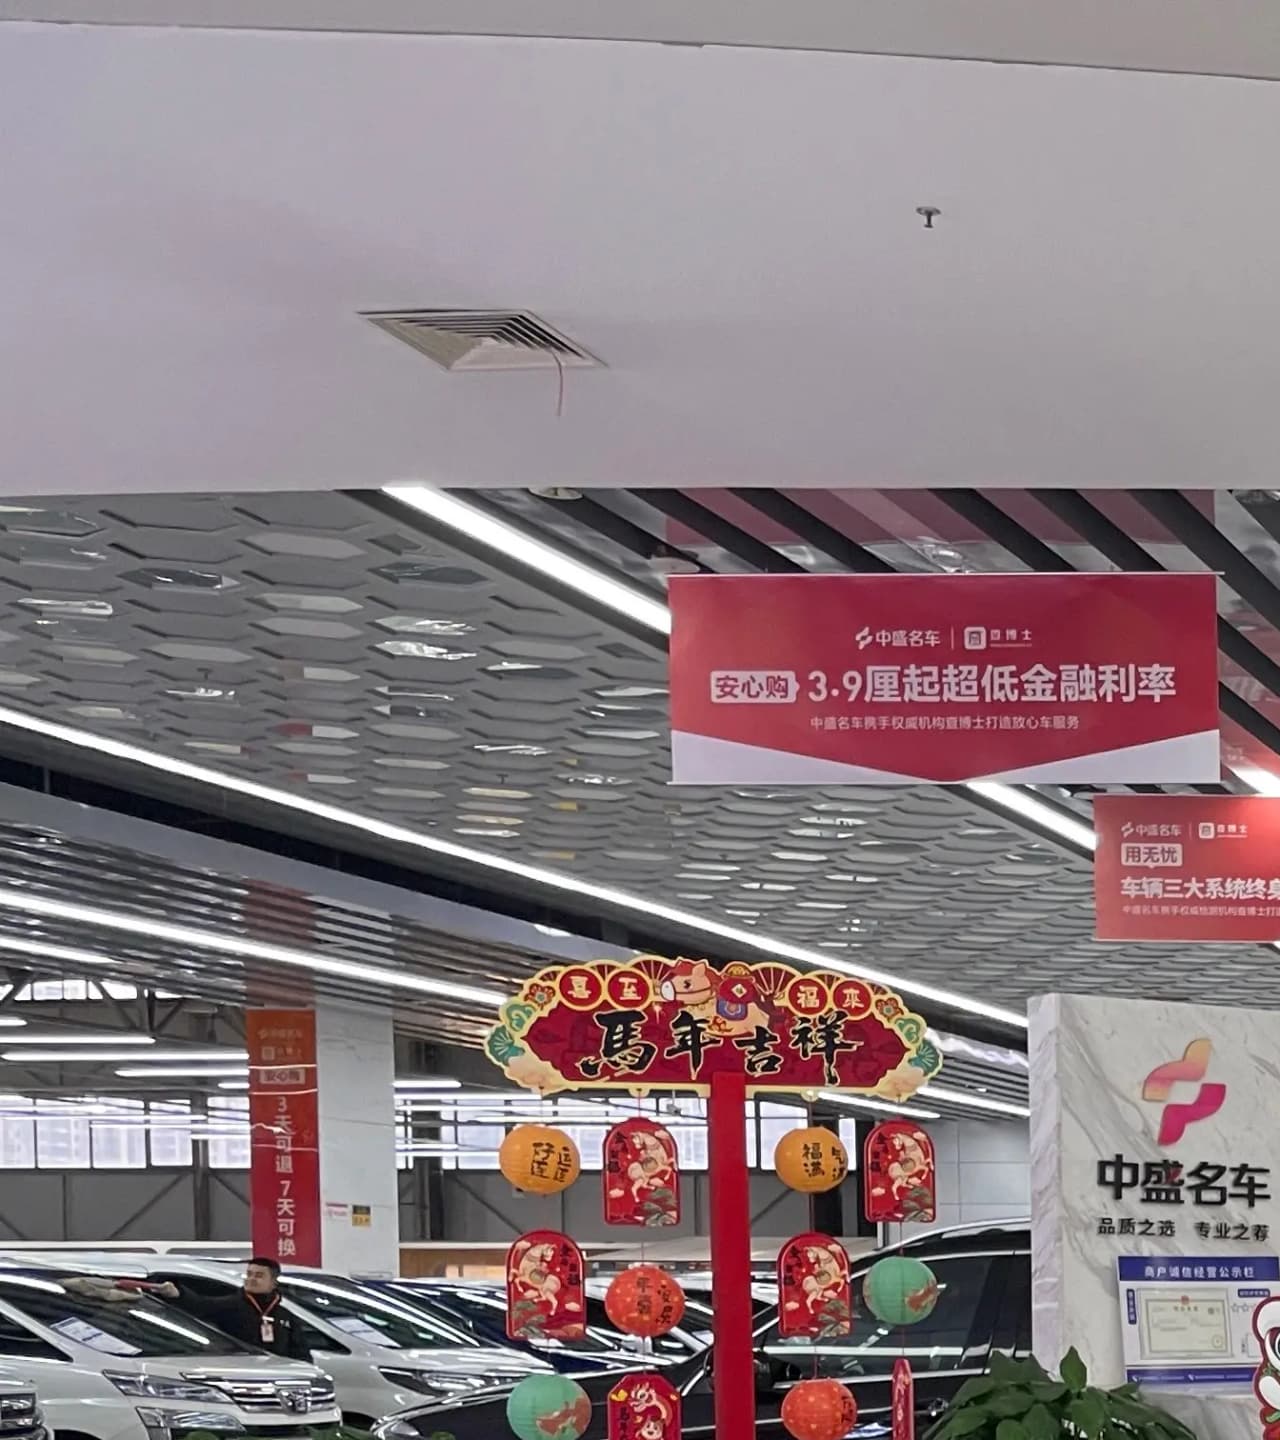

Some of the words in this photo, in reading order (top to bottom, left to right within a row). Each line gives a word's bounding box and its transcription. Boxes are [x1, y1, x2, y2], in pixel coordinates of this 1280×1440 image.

[875, 627, 941, 648] 中盛名车
[715, 674, 790, 699] 安心购
[808, 664, 1177, 704] 3.9厘起超低金融利率
[1135, 824, 1182, 836] 中盛名车
[1125, 846, 1179, 864] 用无忧
[576, 1009, 863, 1085] 馬年吉祥
[1097, 1153, 1271, 1208] 中盛名车
[276, 1181, 296, 1256] 7天可换
[1097, 1217, 1176, 1238] 品质之选
[1194, 1221, 1270, 1242] 专业之荐
